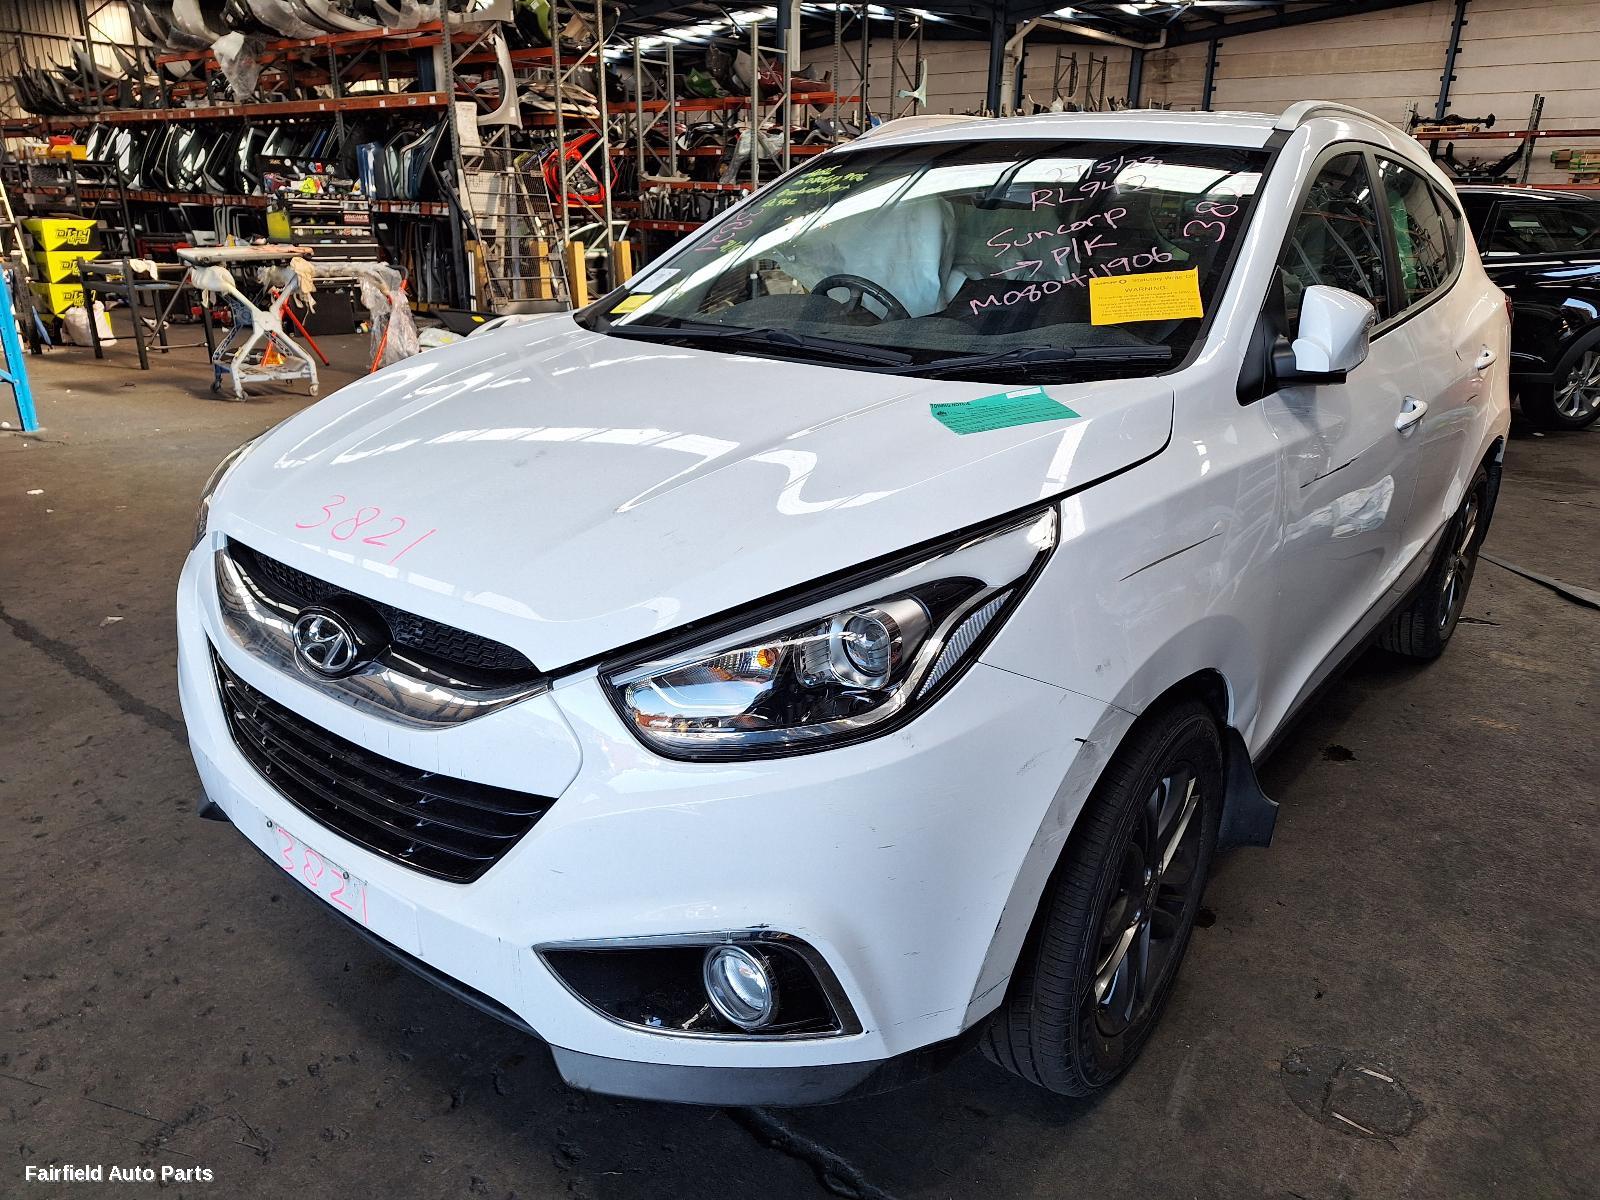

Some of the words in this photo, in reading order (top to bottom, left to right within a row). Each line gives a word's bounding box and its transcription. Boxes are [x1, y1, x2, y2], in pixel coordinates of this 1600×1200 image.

[1031, 174, 1157, 212] RL942
[986, 207, 1128, 258] Suncorp
[1050, 234, 1118, 267] P/K
[295, 494, 438, 566] 3821
[276, 826, 369, 925] 3821
